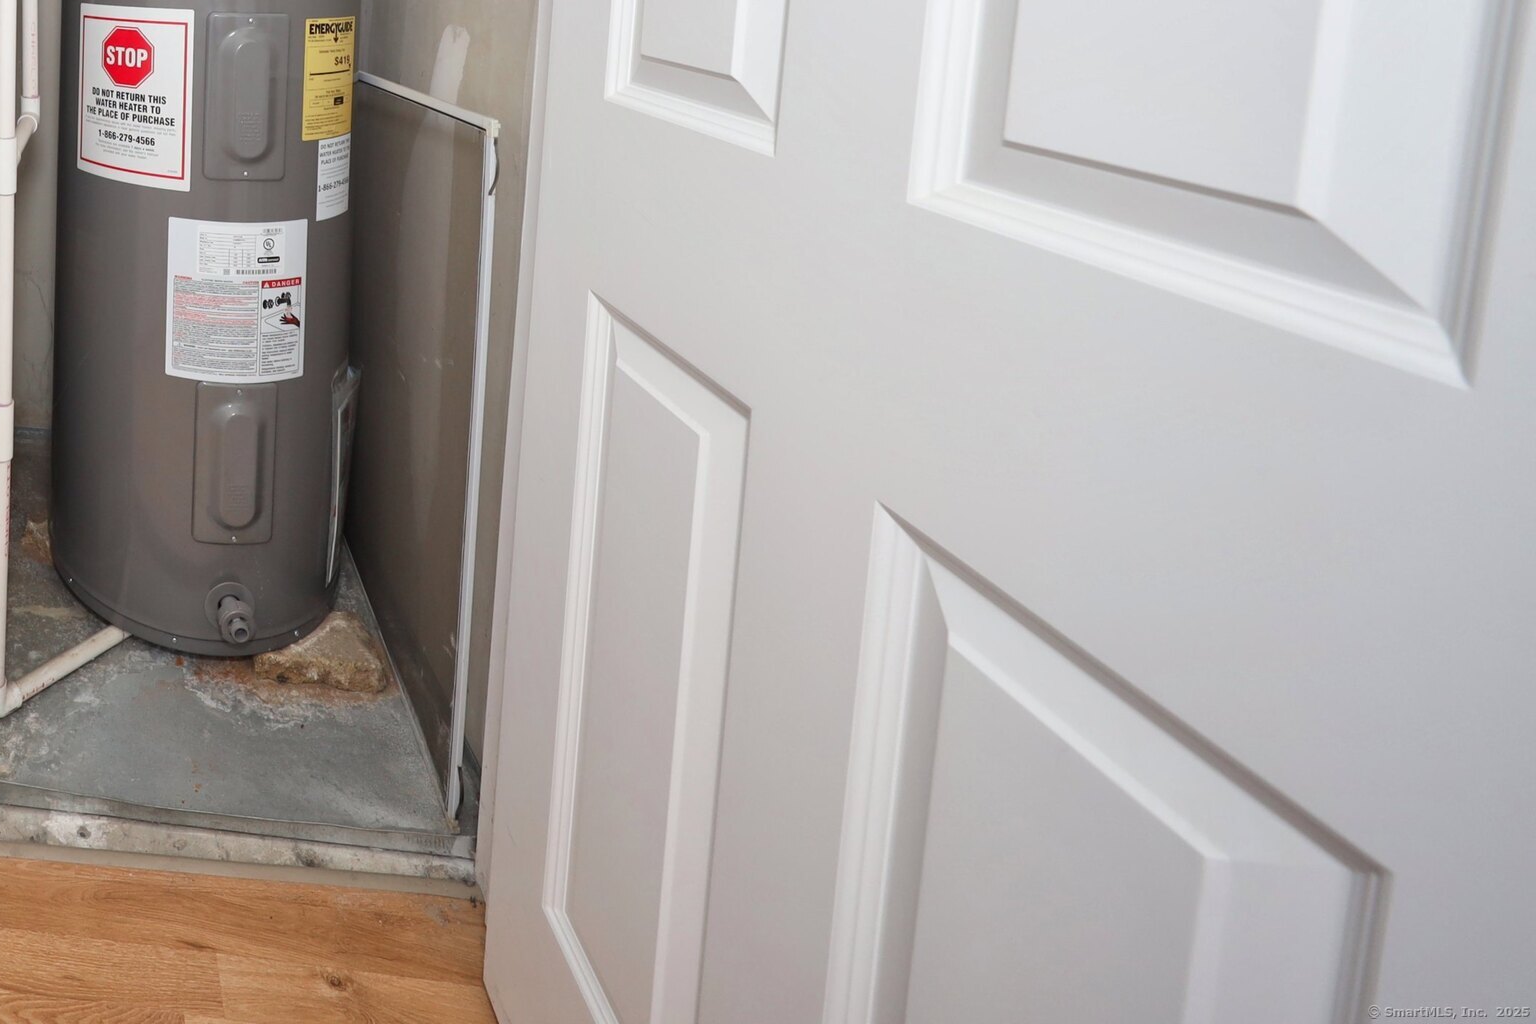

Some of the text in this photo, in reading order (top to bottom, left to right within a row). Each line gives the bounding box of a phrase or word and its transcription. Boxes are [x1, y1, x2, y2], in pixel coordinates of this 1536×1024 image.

[105, 45, 149, 69] STOP
[92, 87, 167, 105] DO NOT RETURN THIS
[95, 97, 161, 115] WATER HEATER TO
[86, 105, 97, 115] THE
[97, 108, 119, 120] PLACE
[120, 112, 130, 121] OF
[132, 113, 176, 127] PURCHASE
[98, 129, 156, 146] 1-866-279-4566
[271, 278, 300, 287] DANGER
